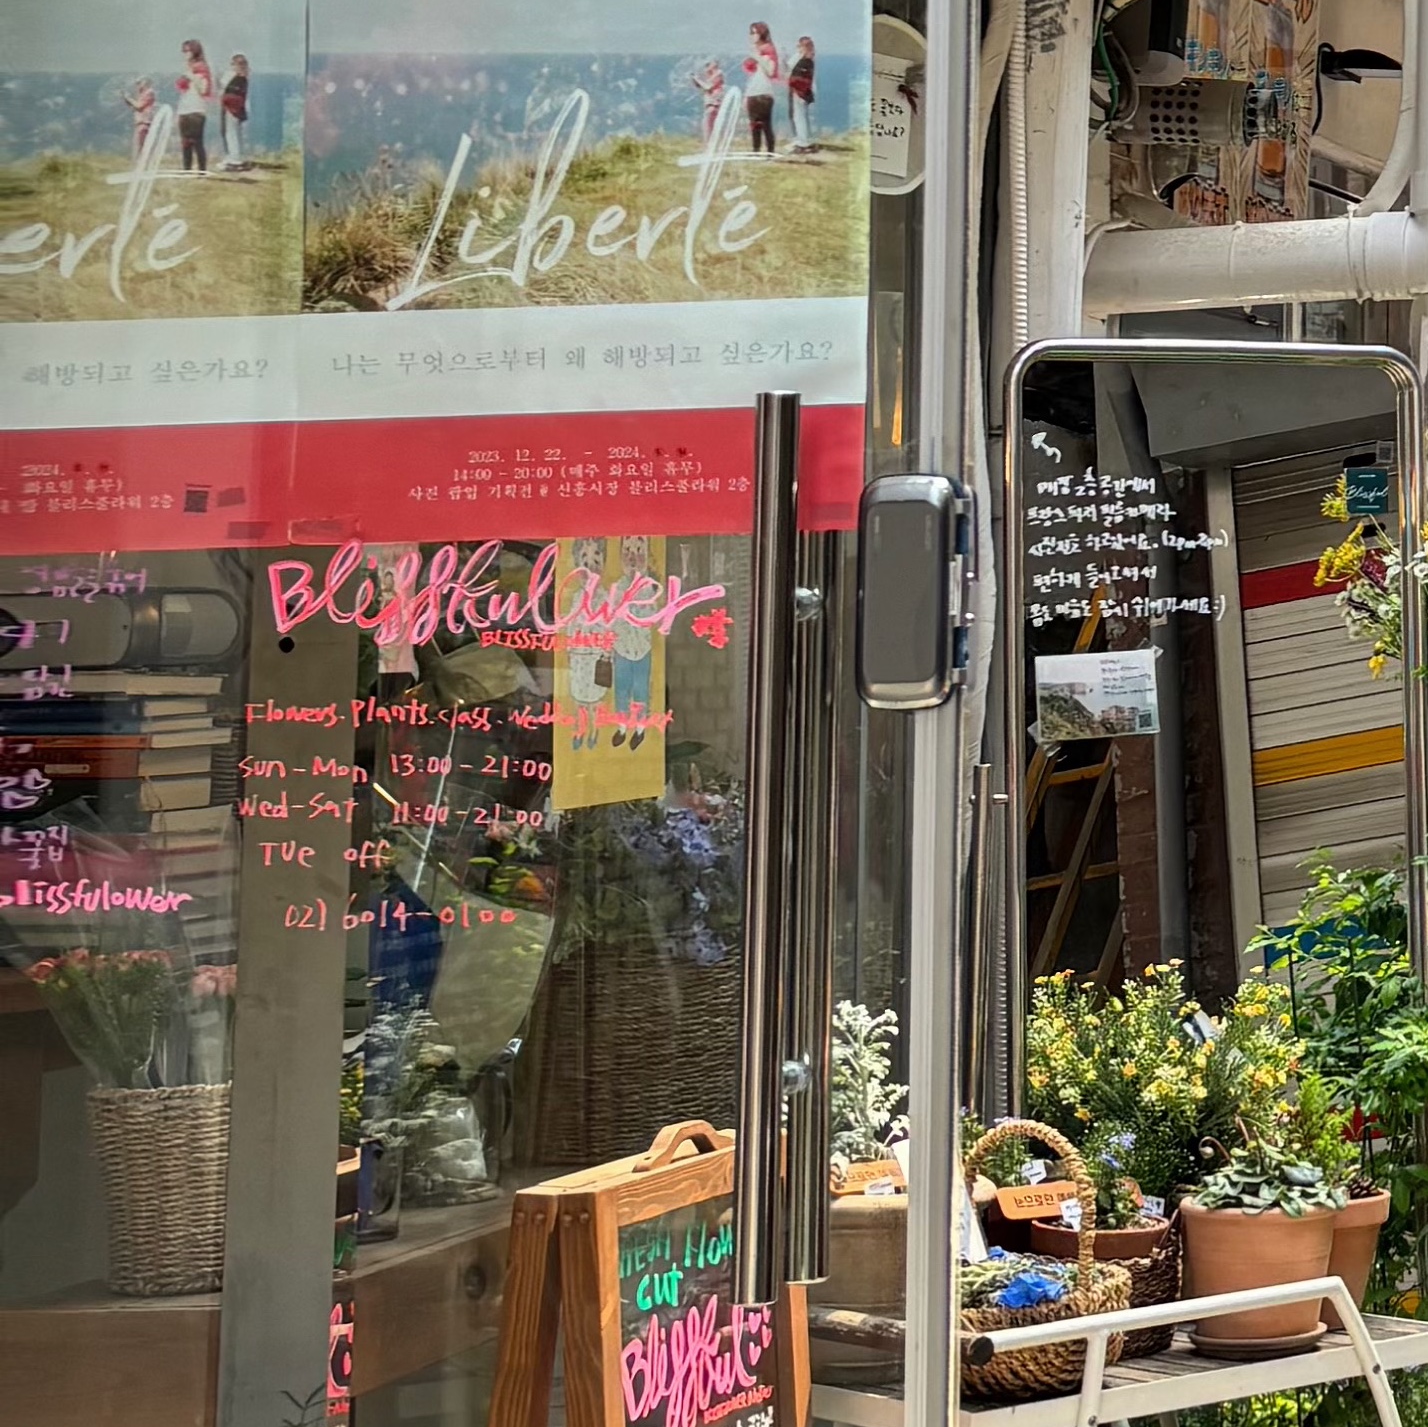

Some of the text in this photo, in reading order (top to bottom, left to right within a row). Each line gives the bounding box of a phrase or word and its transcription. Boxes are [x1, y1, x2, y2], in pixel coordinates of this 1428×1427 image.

[386, 86, 791, 311] Liberté
[150, 358, 269, 384] 싶은가요?
[332, 340, 833, 376] 나는 무엇으로부터 왜 해방되고 싶은가요?
[467, 449, 506, 463] 2023.
[515, 448, 535, 462] 12.
[453, 468, 493, 482] 14:00
[513, 467, 553, 480] 20:00
[238, 756, 287, 779] Sun
[312, 756, 369, 784] Mon
[389, 753, 452, 777] 13:00
[480, 754, 552, 782] 21:00
[342, 839, 392, 869] off
[284, 898, 327, 932] 02)
